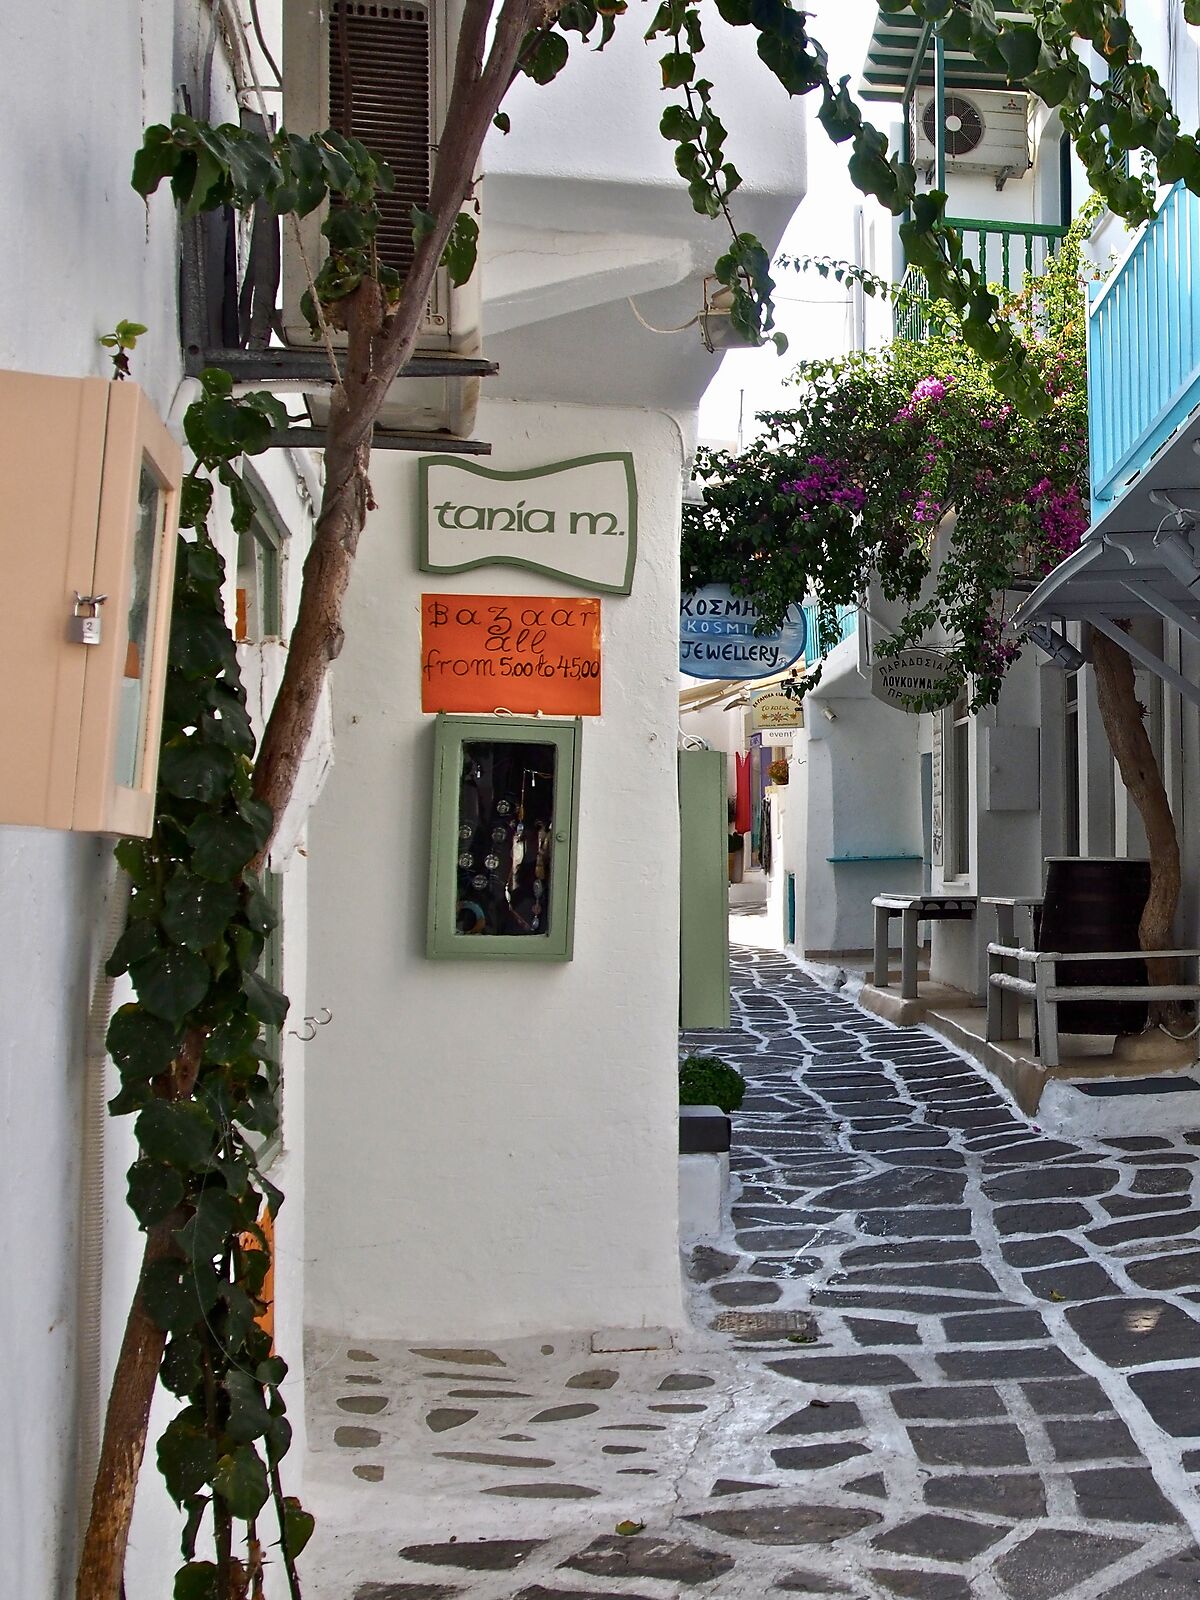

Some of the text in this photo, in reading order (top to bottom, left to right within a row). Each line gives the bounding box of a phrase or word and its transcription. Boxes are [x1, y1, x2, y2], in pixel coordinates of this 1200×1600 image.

[569, 511, 625, 537] m.
[427, 601, 596, 636] Bazaar
[680, 597, 790, 622] ΚΟΣΜΗ
[484, 628, 547, 654] all
[686, 619, 768, 637] KOSMI
[423, 649, 496, 681] from
[535, 654, 555, 677] to
[681, 640, 780, 668] JEWELLERY
[879, 657, 955, 676] ΠΑΡΑΔΟΣΙΑΚ
[882, 675, 940, 690] ΛΟΥΚΟΥΜΑ
